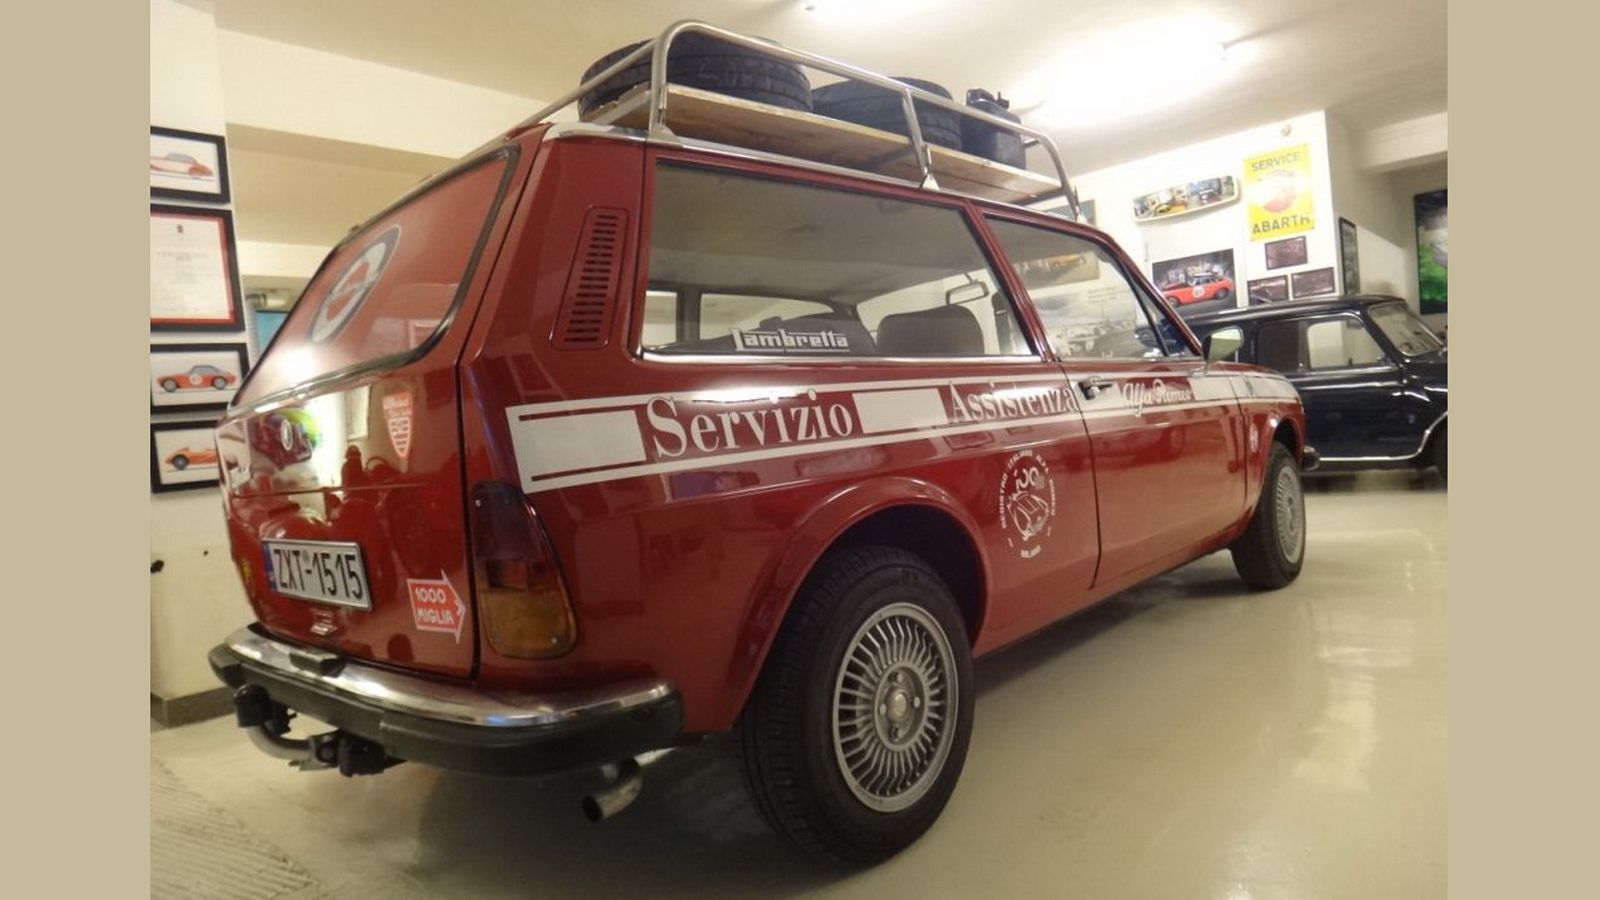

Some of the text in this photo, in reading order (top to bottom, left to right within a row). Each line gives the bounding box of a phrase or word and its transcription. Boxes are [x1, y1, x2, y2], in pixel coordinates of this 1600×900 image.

[1251, 151, 1301, 172] SERVICE
[1252, 215, 1311, 234] ABARTH
[732, 327, 850, 352] Lambretta
[1121, 378, 1194, 418] Alfa Romeo
[647, 380, 1079, 459] Servizio Assistenza
[273, 549, 364, 600] ZXT-1515
[414, 586, 446, 604] 1000
[416, 608, 455, 625] MIGLIA
